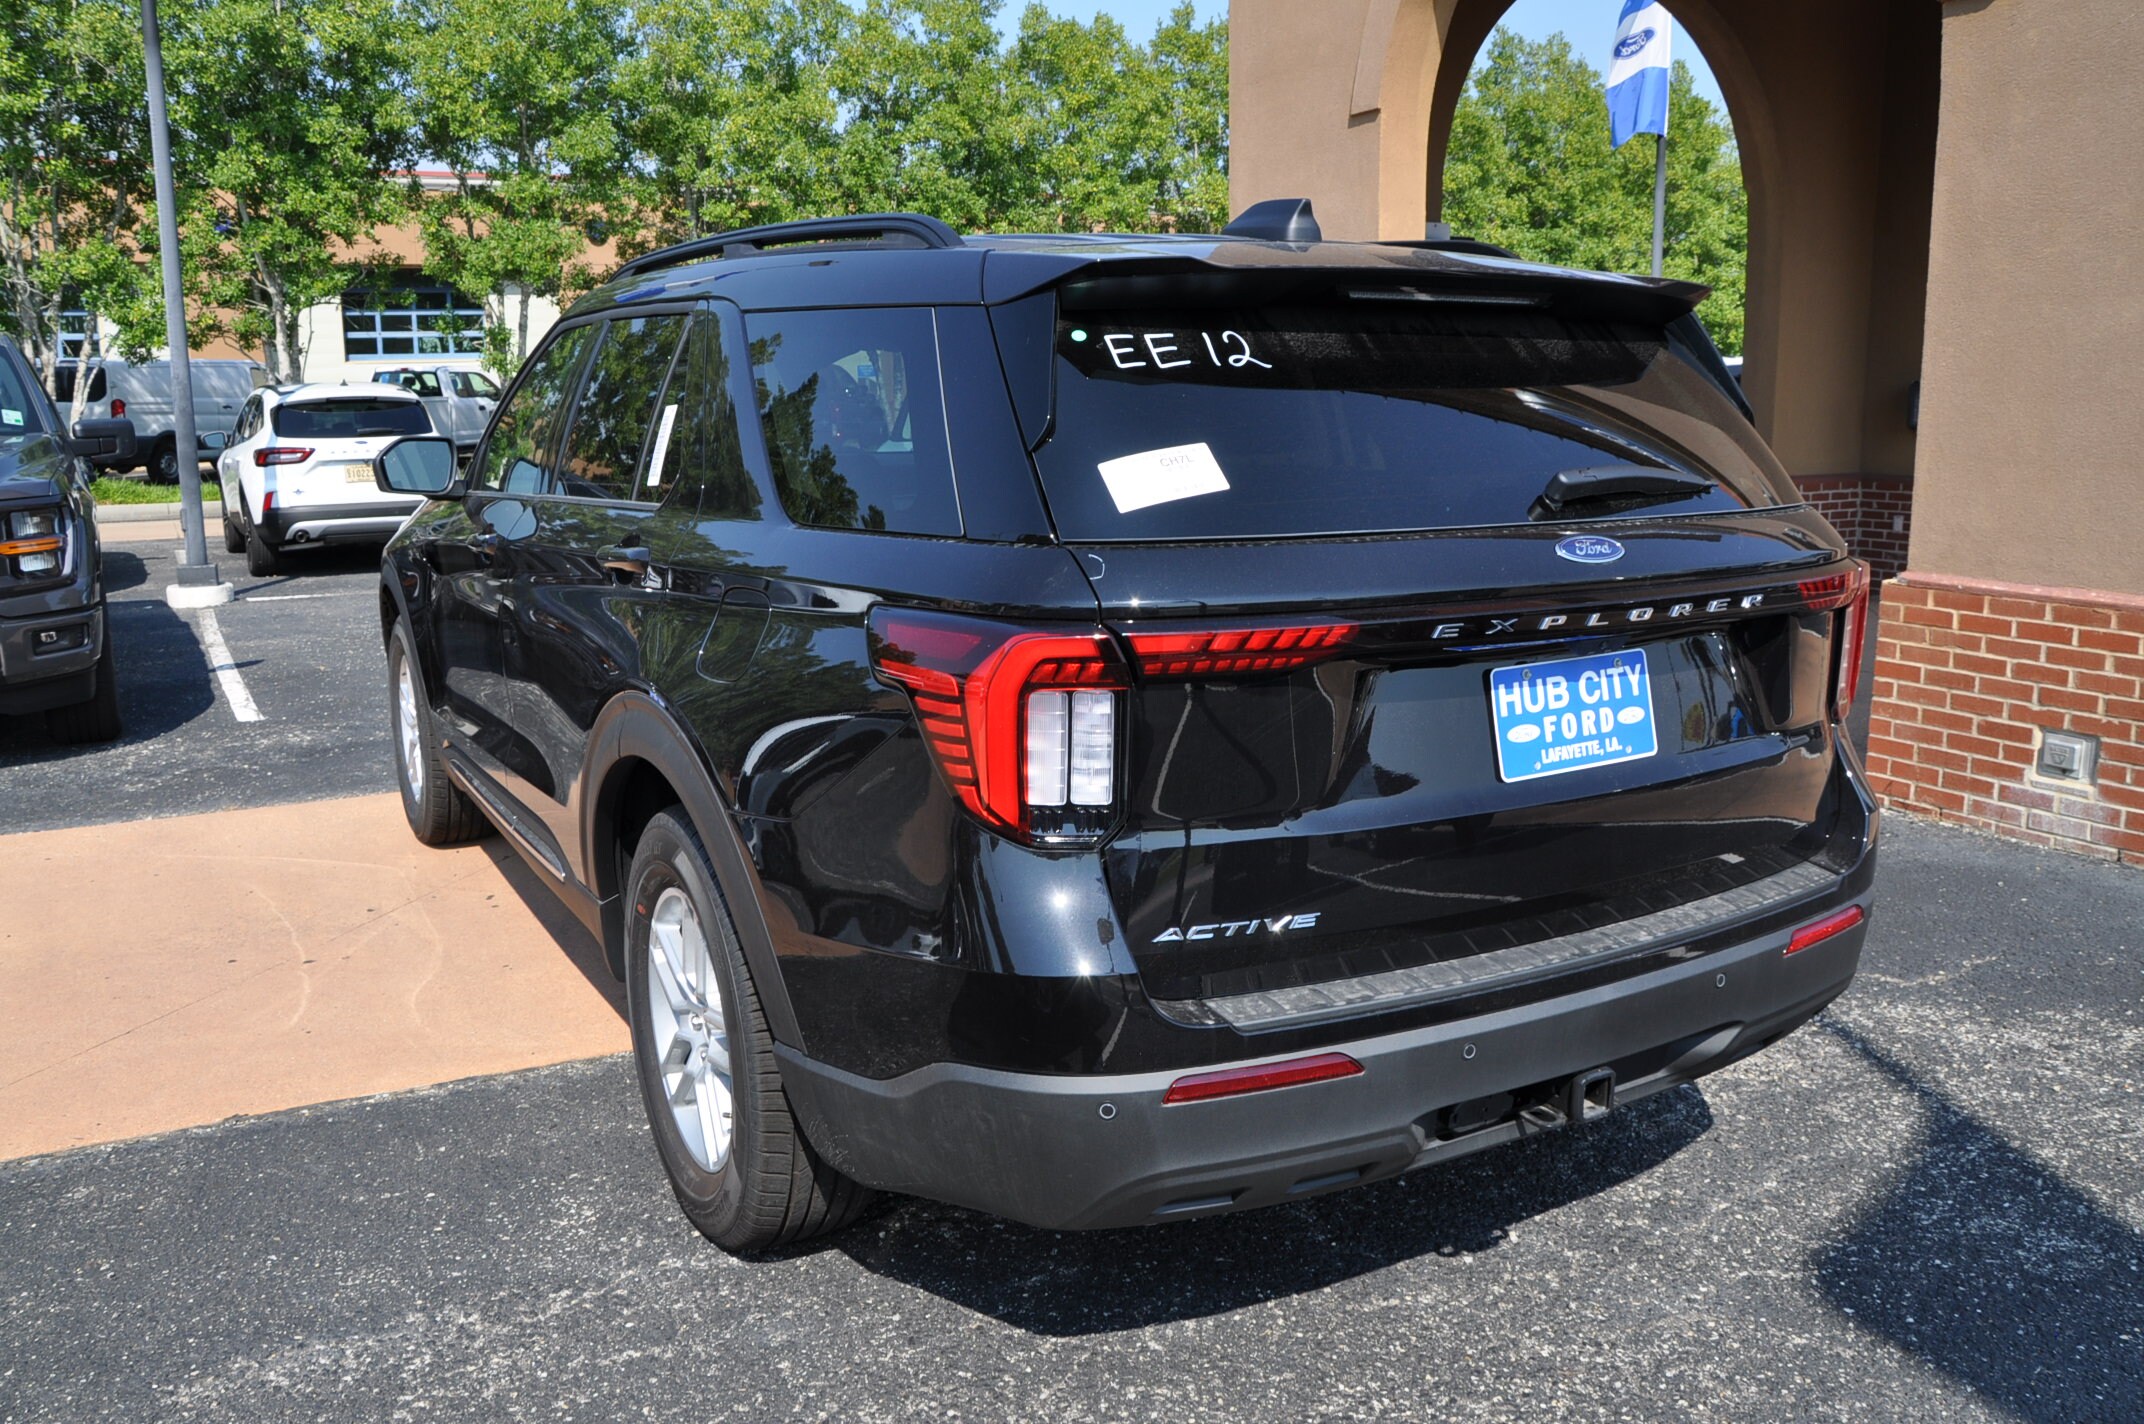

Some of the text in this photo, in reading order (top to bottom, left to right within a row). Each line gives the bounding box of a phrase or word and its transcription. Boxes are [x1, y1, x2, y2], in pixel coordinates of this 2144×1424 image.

[1104, 330, 1273, 368] EE 12
[1575, 540, 1613, 556] Ford
[1430, 594, 1765, 640] EXPLORER
[1498, 674, 1570, 718] HUB
[1578, 663, 1642, 705] CITY
[1543, 706, 1615, 743] FORD
[1541, 739, 1604, 764] LAFAYETTE,
[1152, 912, 1321, 943] ACTIVE
